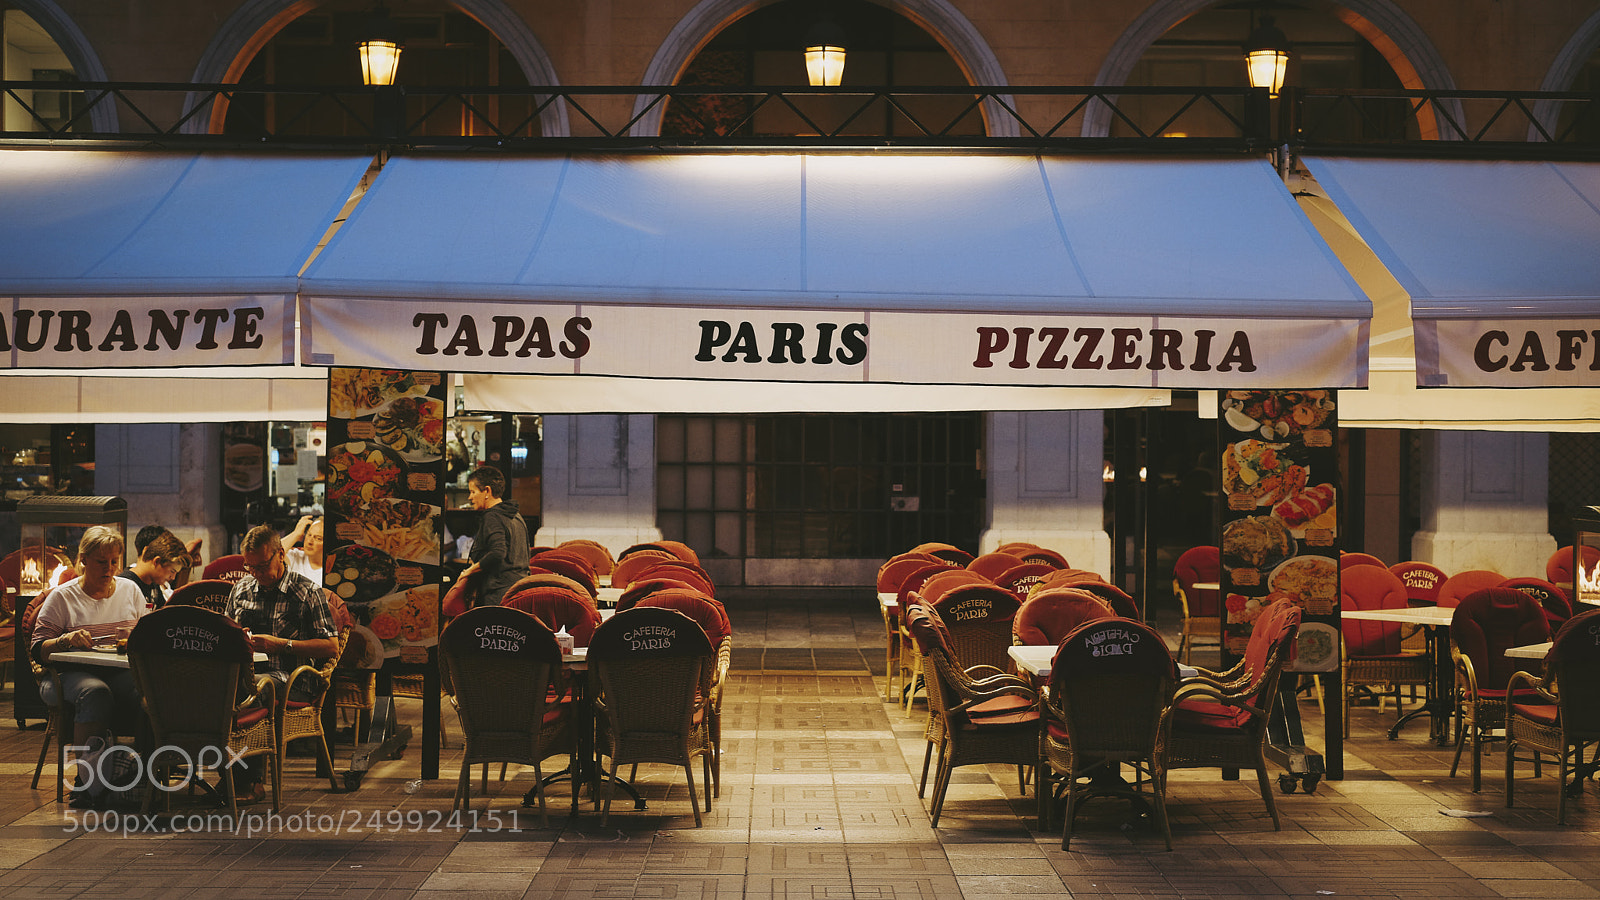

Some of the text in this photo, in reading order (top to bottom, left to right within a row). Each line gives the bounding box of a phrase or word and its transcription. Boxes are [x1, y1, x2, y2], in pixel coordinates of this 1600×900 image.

[413, 313, 1257, 372] TAPAS PARIS PIZZERIA
[1474, 330, 1600, 372] CAF
[1402, 569, 1439, 584] CAFETERIA
[1405, 578, 1434, 590] PARIS
[949, 599, 993, 614] CAFETERIA
[956, 608, 988, 621] PARIS
[165, 626, 220, 644] CAFETERIA
[474, 624, 527, 644] CAFETERIA
[623, 625, 676, 641] CAFETERIA
[172, 638, 214, 652] PARIS
[480, 637, 520, 652] PARIS
[631, 637, 671, 651] PARIS
